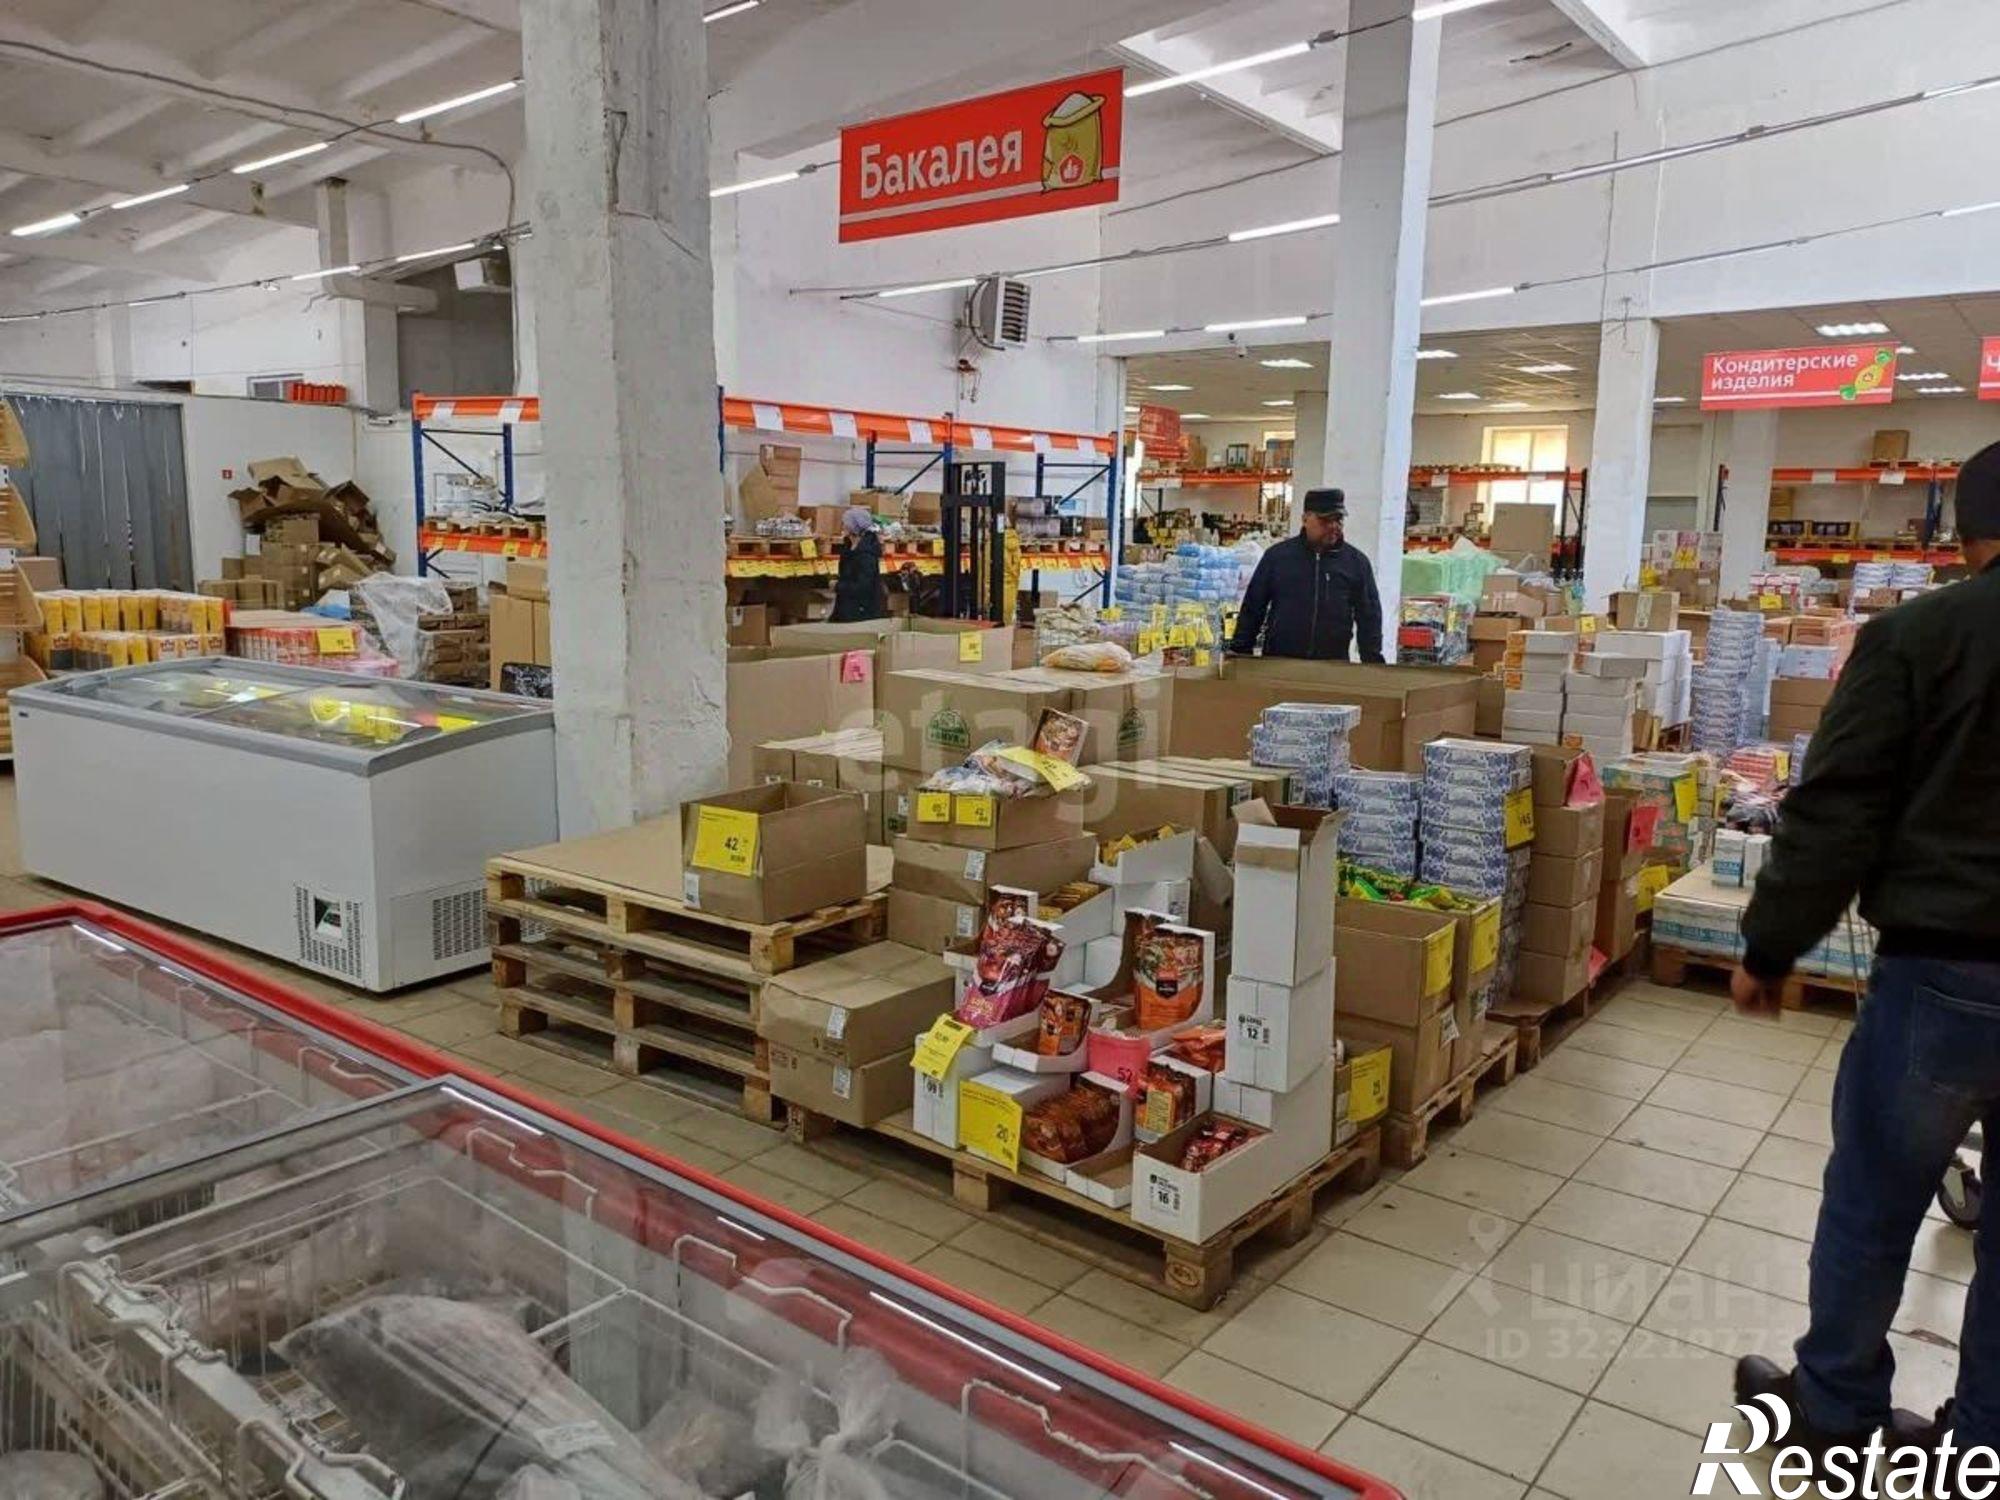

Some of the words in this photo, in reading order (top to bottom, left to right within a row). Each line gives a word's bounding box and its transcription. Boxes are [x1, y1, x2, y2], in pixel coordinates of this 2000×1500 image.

[860, 130, 1023, 200] Бакалея
[1712, 352, 1859, 375] Кондитерские
[1711, 374, 1795, 391] изделия
[724, 836, 739, 850] 42
[1247, 1027, 1258, 1040] 12
[1158, 1191, 1169, 1204] 16
